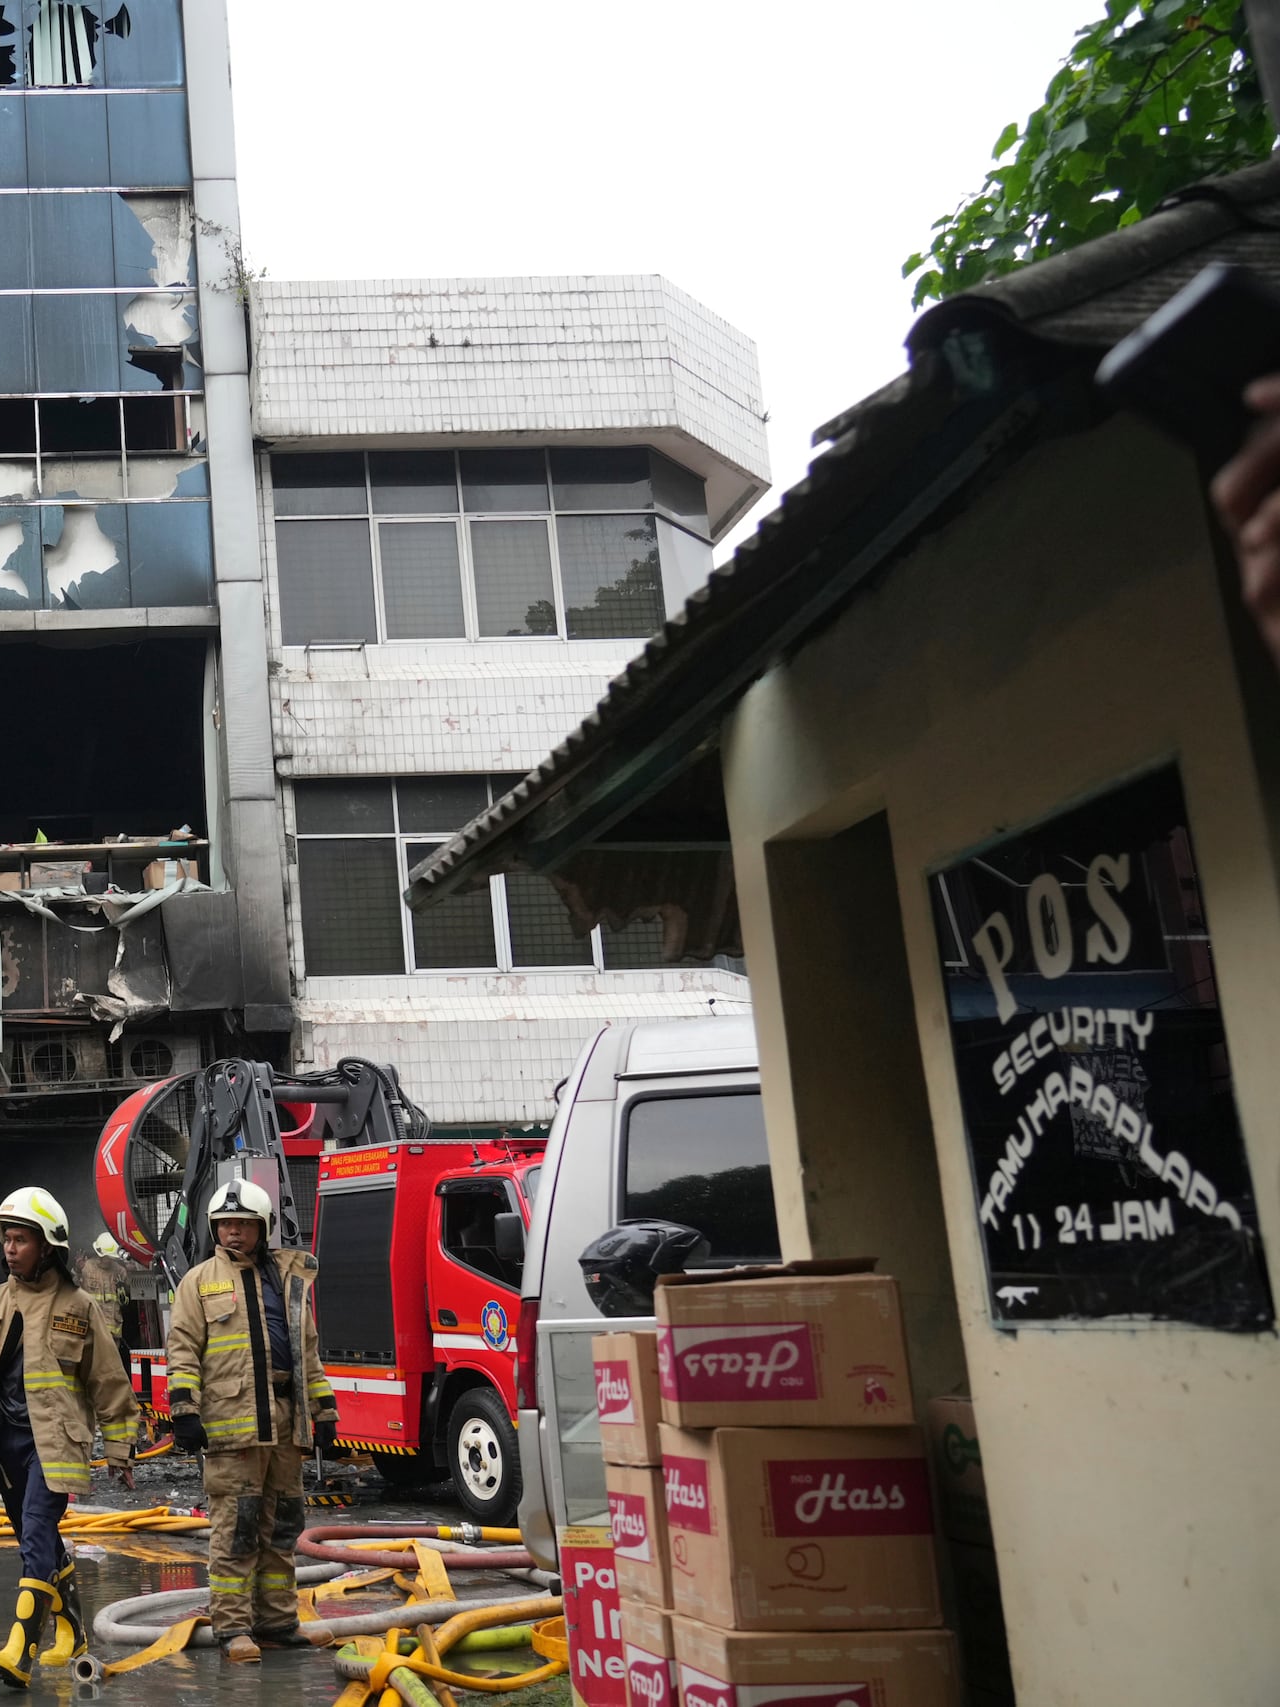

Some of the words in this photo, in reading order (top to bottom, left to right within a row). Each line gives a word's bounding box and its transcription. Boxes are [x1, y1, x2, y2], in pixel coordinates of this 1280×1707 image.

[972, 853, 1132, 1026] POS
[992, 1006, 1154, 1095] SECURITY
[343, 1153, 361, 1165] PEMADAM
[361, 1163, 380, 1173] JAKARTA
[980, 1115, 1034, 1231] TAMU
[1055, 1203, 1093, 1244] 24
[1099, 1197, 1175, 1241] JAM
[683, 1340, 800, 1388] Hass
[597, 1368, 630, 1411] Hass
[665, 1468, 706, 1513] Hass
[794, 1473, 906, 1524] Hass
[611, 1500, 646, 1542] Hass
